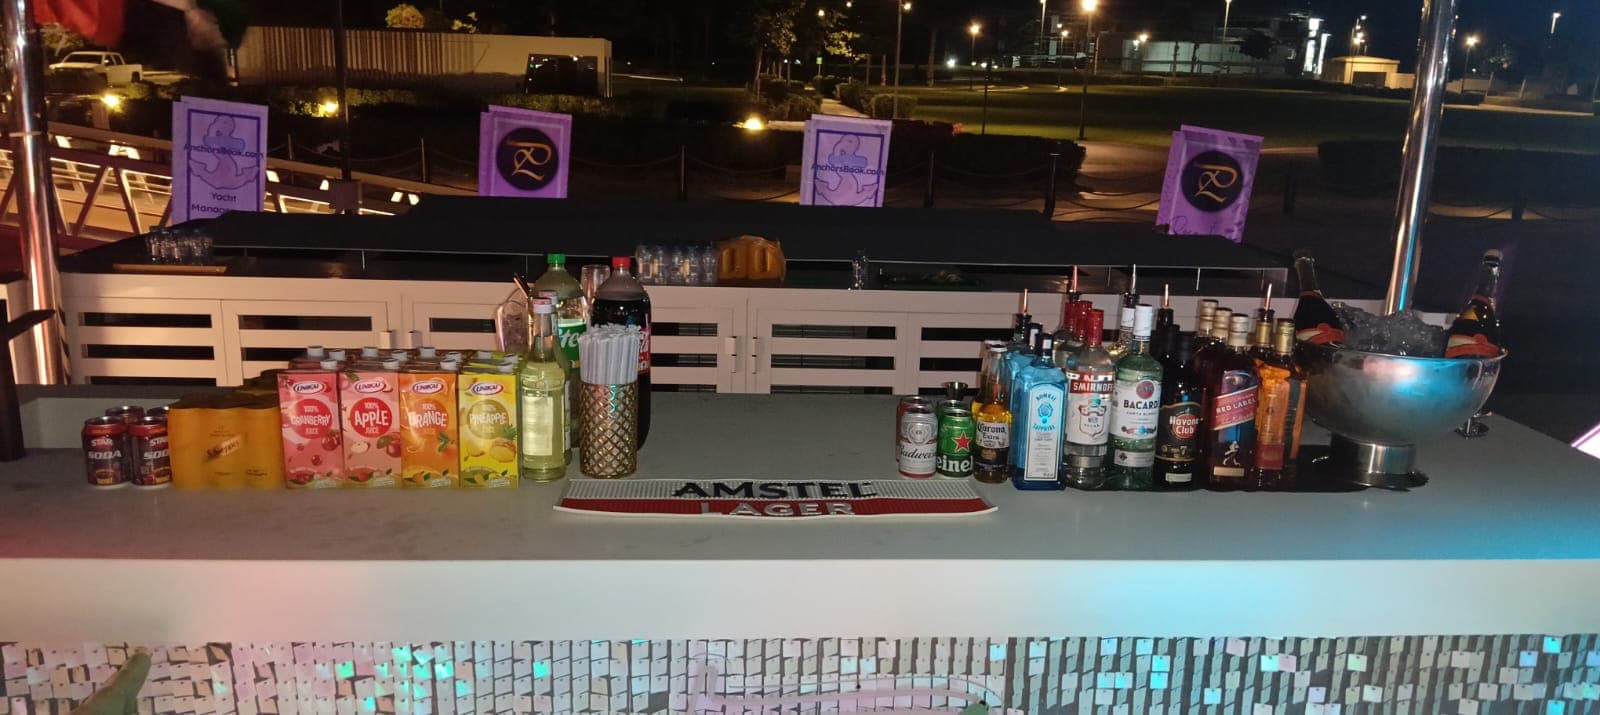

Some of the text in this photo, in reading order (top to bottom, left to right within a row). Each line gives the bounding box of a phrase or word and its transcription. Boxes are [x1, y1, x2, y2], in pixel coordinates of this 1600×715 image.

[184, 144, 264, 158] AnchorsBook.com
[811, 163, 884, 176] AnchorsBook.com
[212, 191, 237, 202] Yacht
[1216, 398, 1256, 414] RED LABEL
[290, 414, 331, 427] CRANBERRY
[354, 407, 390, 429] APPLE
[407, 409, 448, 429] ORANGE
[469, 412, 507, 425] PINEAPPLE
[977, 422, 1007, 433] Corona
[1176, 425, 1194, 435] Club
[88, 449, 122, 460] SODA
[144, 448, 170, 460] SOD
[672, 481, 878, 499] AMSTEL
[701, 501, 856, 517] LAGER
